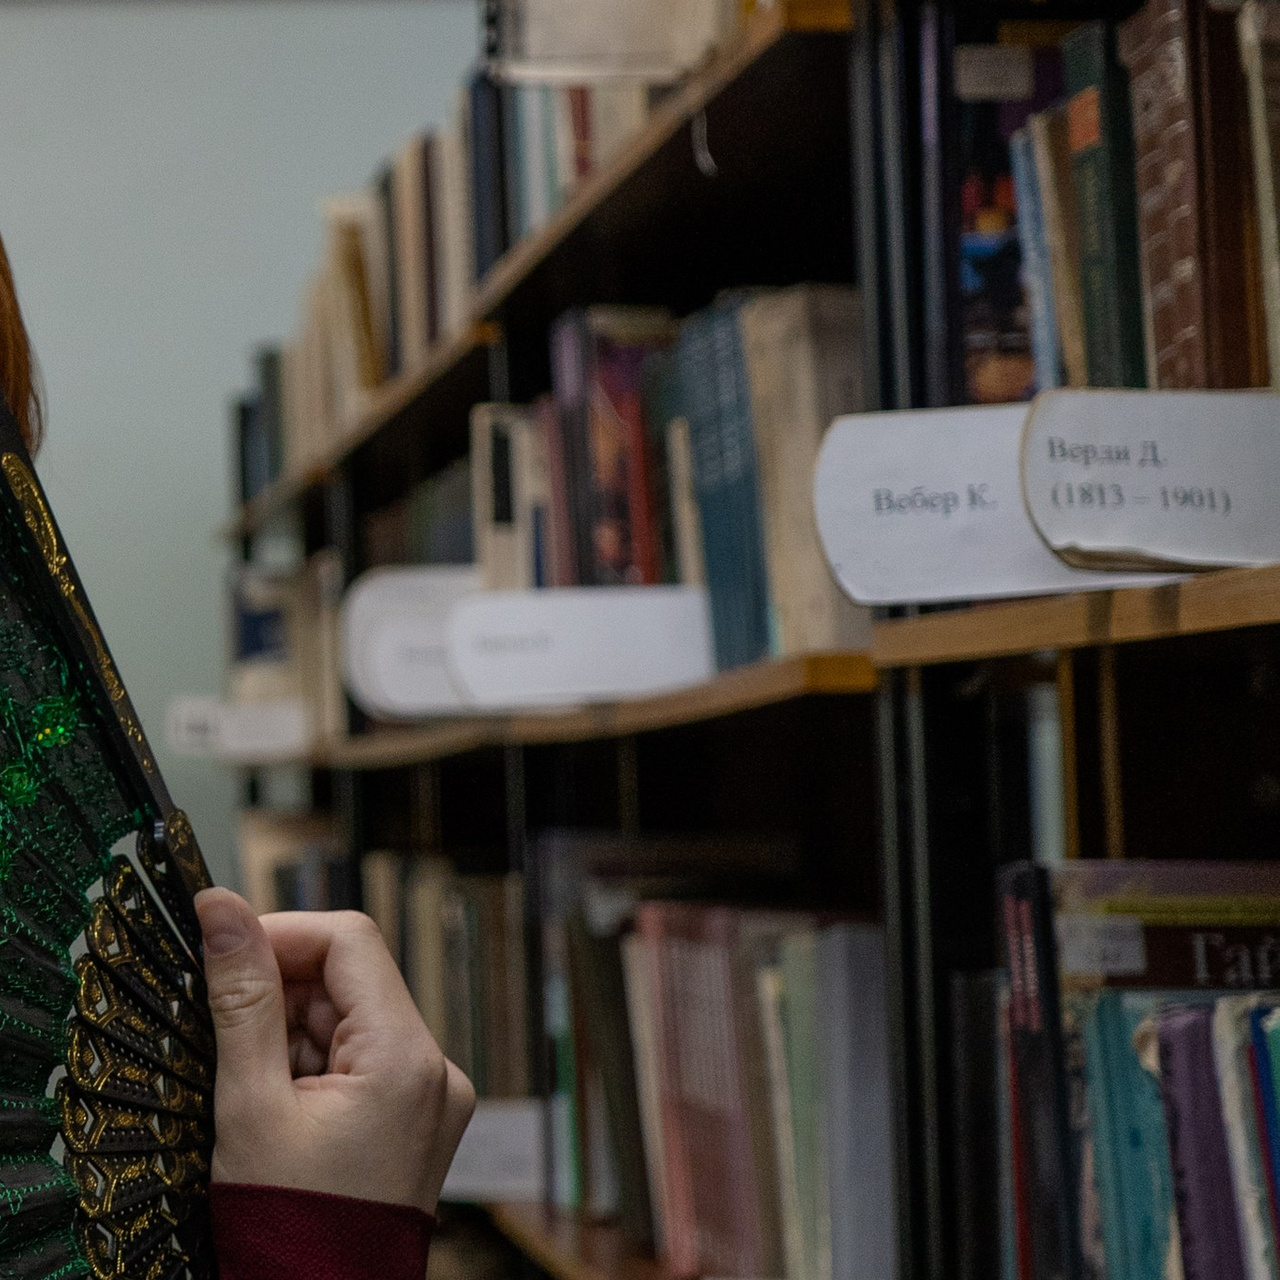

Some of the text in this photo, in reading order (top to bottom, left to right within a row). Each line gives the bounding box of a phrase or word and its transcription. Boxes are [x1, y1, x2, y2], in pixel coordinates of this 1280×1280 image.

[1047, 437, 1130, 467] Верди
[873, 485, 960, 518] Вебер
[1050, 482, 1124, 509] (1813
